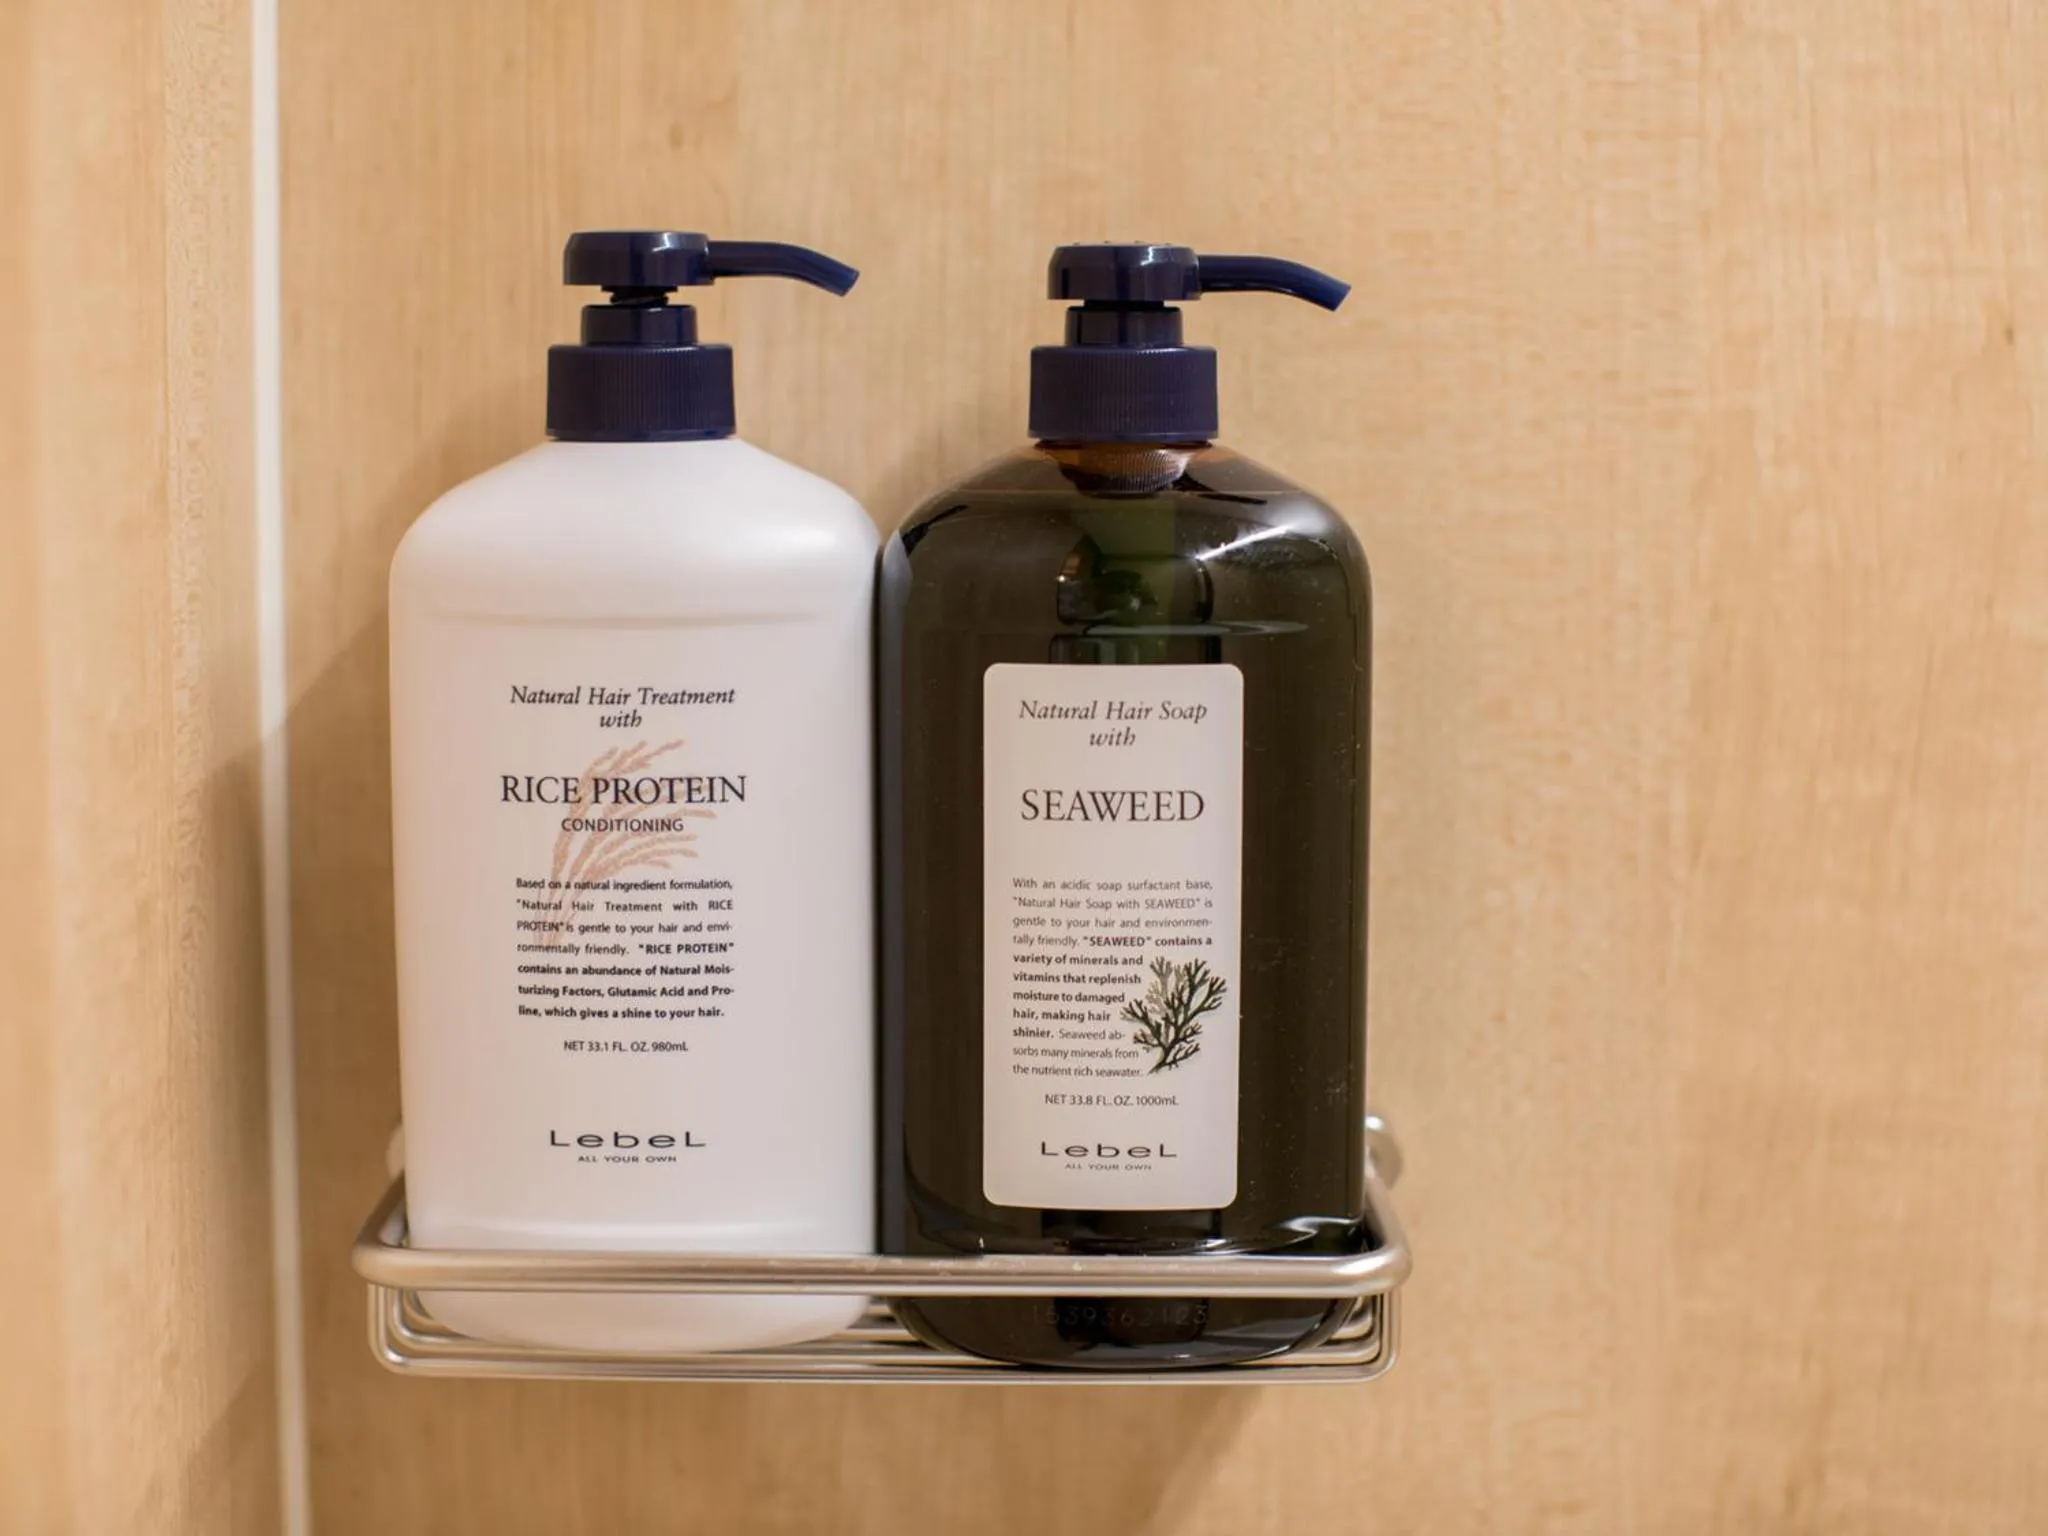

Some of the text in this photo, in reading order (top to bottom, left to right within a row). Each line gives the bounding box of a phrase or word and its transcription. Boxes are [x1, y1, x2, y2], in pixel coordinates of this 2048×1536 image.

[510, 685, 735, 706] Natural Hair Treatment
[600, 709, 642, 729] with
[1019, 699, 1208, 725] Natural Hair Soap
[1089, 726, 1136, 747] with
[501, 774, 747, 805] RICE PROTEIN
[1021, 788, 1205, 822] SEAWEED
[561, 817, 684, 833] CONDITIONING
[516, 877, 733, 893] Based on a natural ingredient formulation,
[1013, 877, 1213, 893] With an acidic soap surfactant base,
[572, 899, 594, 912] Hair
[606, 900, 662, 913] Treatment
[673, 900, 698, 912] with
[708, 898, 733, 911] RICE
[1060, 896, 1081, 909] Hair
[1086, 897, 1112, 912] Soap
[1117, 898, 1140, 910] with
[1203, 897, 1214, 909] is
[565, 920, 575, 934] is
[578, 921, 611, 936] gentle
[615, 923, 627, 934] to
[630, 924, 654, 936] your
[659, 922, 678, 934] hair
[683, 921, 702, 933] and
[1013, 915, 1046, 929] gentle
[1050, 917, 1062, 928] to
[1066, 918, 1090, 930] your
[1095, 916, 1115, 929] hair
[1120, 917, 1140, 930] and
[517, 942, 580, 957] ronmentally
[585, 942, 630, 957] friendly.
[1013, 934, 1034, 949] tally
[1037, 934, 1080, 949] friendly.
[1155, 935, 1203, 948] contains
[1204, 936, 1213, 946] a
[1013, 953, 1143, 967] variety of minerals and
[518, 963, 561, 975] contains
[565, 966, 578, 976] an
[582, 964, 641, 977] abundance
[644, 964, 658, 977] of
[660, 963, 701, 977] Natural
[1013, 971, 1142, 987] vitamins that replenish
[518, 983, 559, 999] turizing
[562, 985, 605, 999] Factors,
[607, 986, 657, 998] Glutamic
[660, 985, 684, 998] Acid
[687, 985, 708, 997] and
[1013, 989, 1125, 1006] moisture to damaged
[518, 1005, 725, 1020] line, which gives a shine to your hair.
[1013, 1008, 1110, 1024] hair, making hair
[1013, 1027, 1054, 1039] shinier.
[1059, 1027, 1106, 1041] Seaweed
[564, 1040, 584, 1052] NET
[587, 1040, 609, 1053] 33.1
[1013, 1046, 1139, 1061] sorbs many minerals from
[1013, 1064, 1143, 1078] the nutrient rich seawater.
[1045, 1093, 1067, 1105] NET
[1070, 1094, 1093, 1106] 33.8
[550, 1129, 706, 1149] LebeL
[1041, 1141, 1178, 1159] LebeL
[578, 1155, 677, 1164] ALL YOUR OWN
[1065, 1162, 1152, 1171] ALL YOUR OWN
